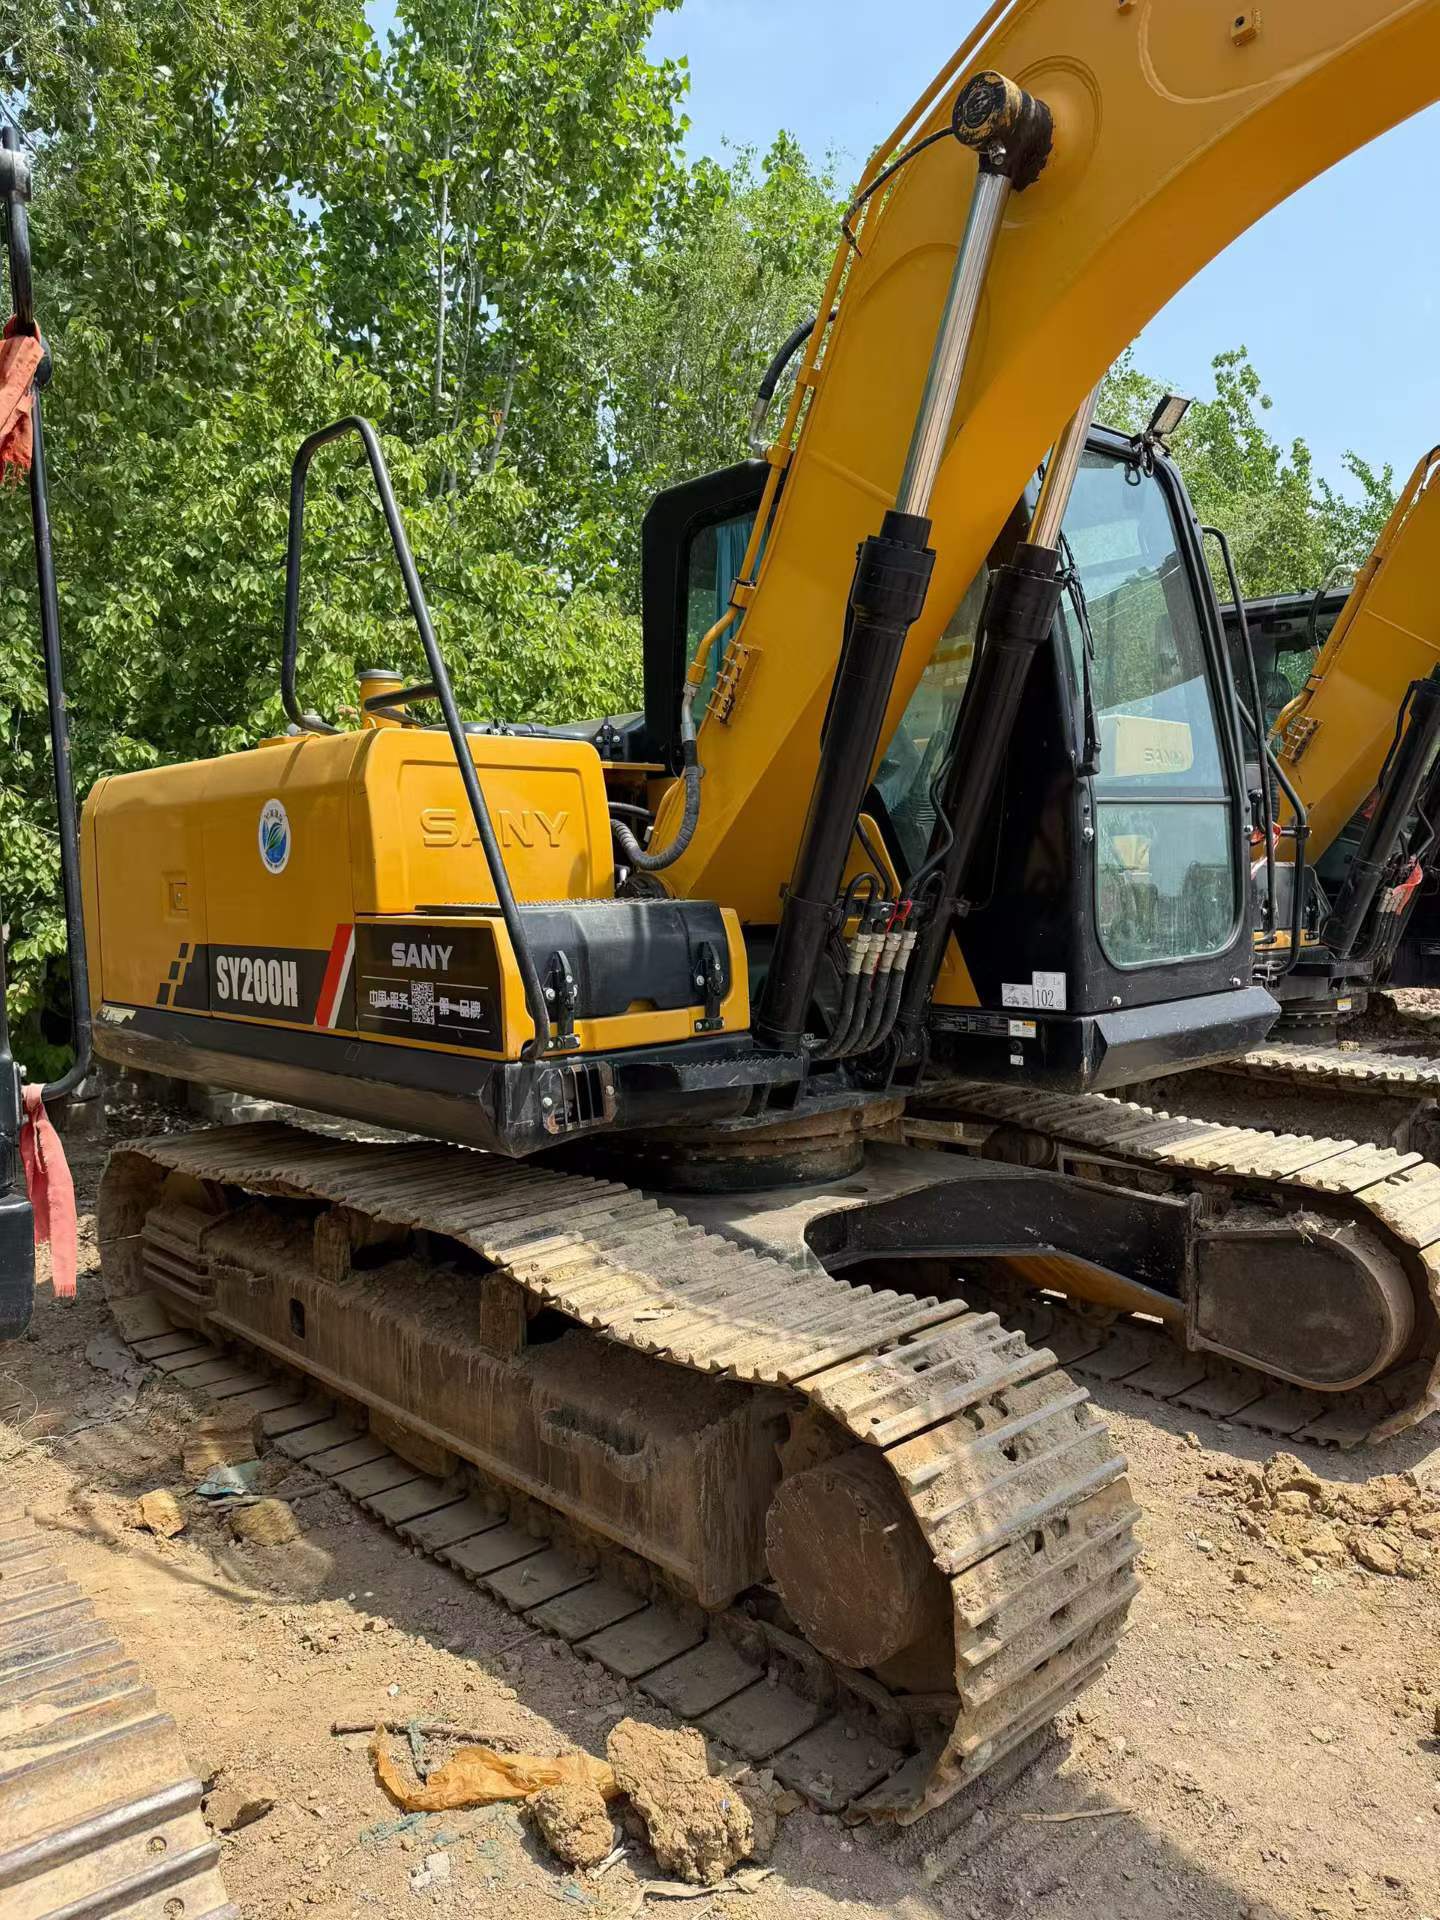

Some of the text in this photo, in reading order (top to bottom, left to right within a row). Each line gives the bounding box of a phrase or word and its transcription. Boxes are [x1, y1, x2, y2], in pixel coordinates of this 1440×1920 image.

[391, 942, 454, 971] SANY
[216, 955, 299, 1008] SY200H
[1036, 989, 1054, 1006] 102
